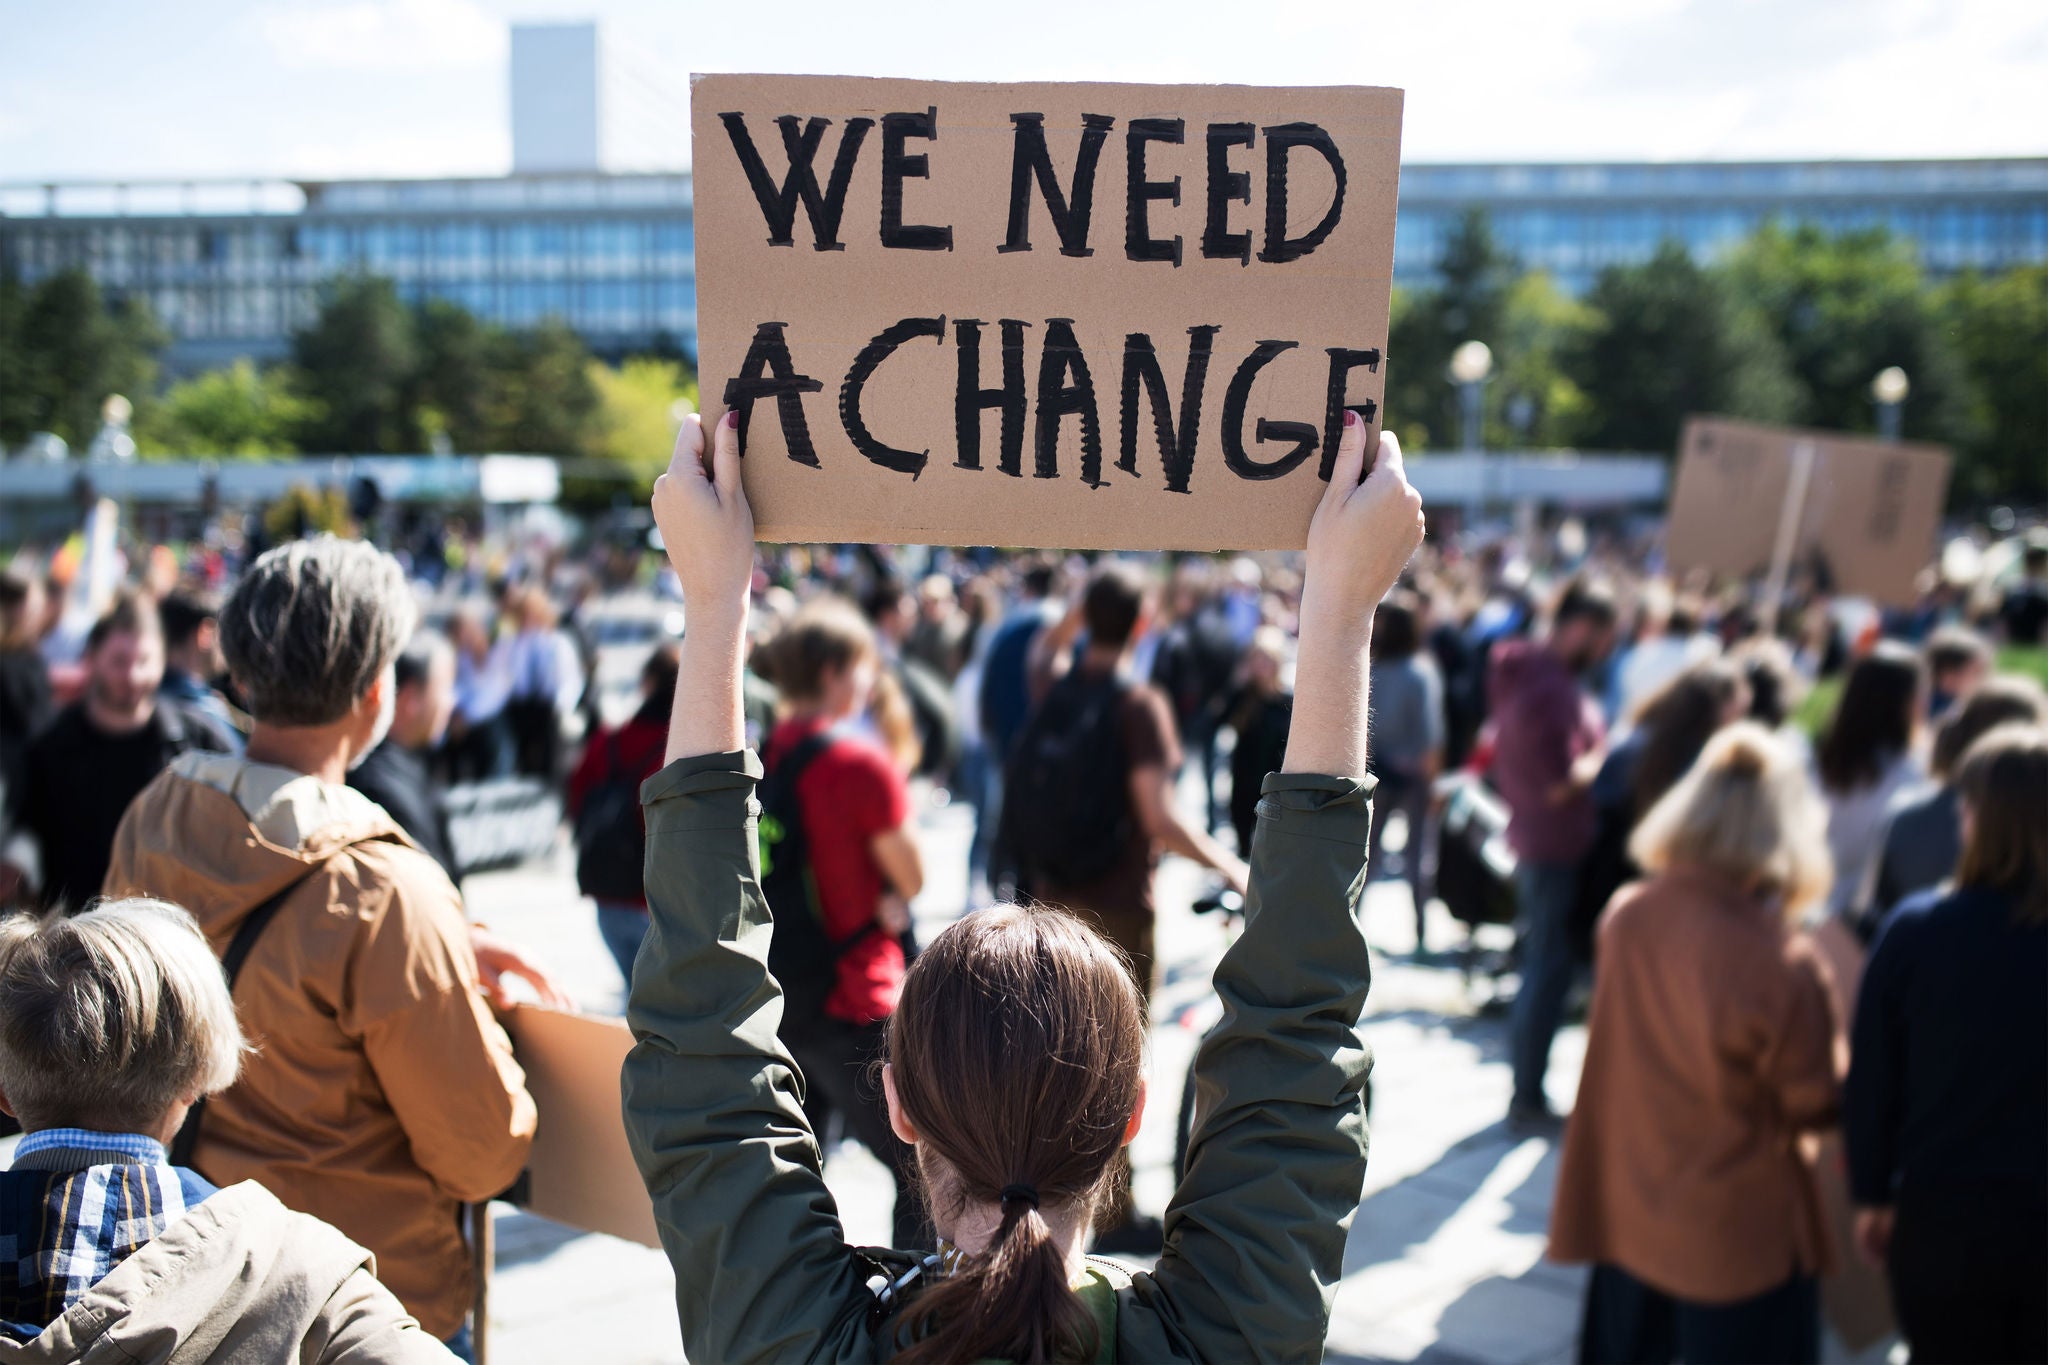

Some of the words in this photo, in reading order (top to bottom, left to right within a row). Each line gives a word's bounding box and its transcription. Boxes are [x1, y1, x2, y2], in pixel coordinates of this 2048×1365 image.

[717, 106, 954, 251] WE
[997, 112, 1347, 267] NEED
[723, 321, 823, 469] A
